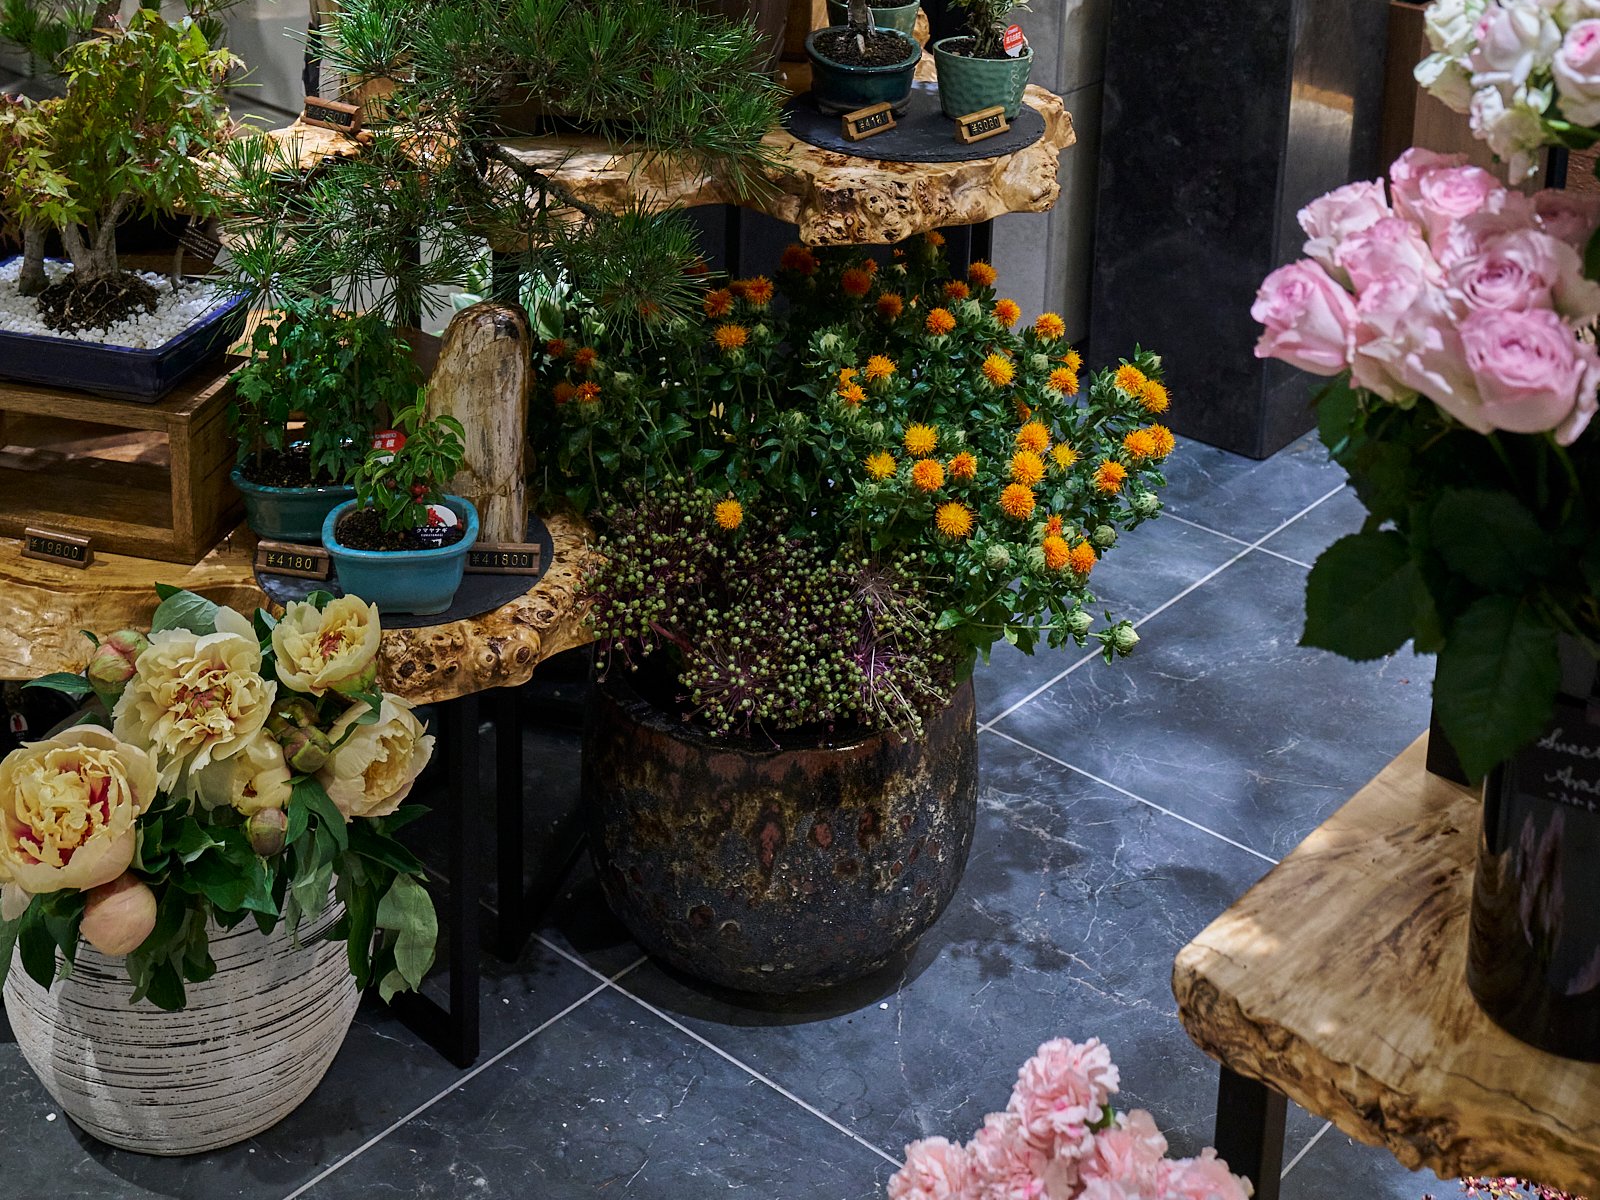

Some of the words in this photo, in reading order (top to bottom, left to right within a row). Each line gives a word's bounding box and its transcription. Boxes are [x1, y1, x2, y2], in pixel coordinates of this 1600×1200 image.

[971, 116, 999, 132] ¥3080
[31, 538, 78, 559] ¥19800
[268, 553, 312, 569] ¥4180
[472, 553, 528, 566] ¥41800
